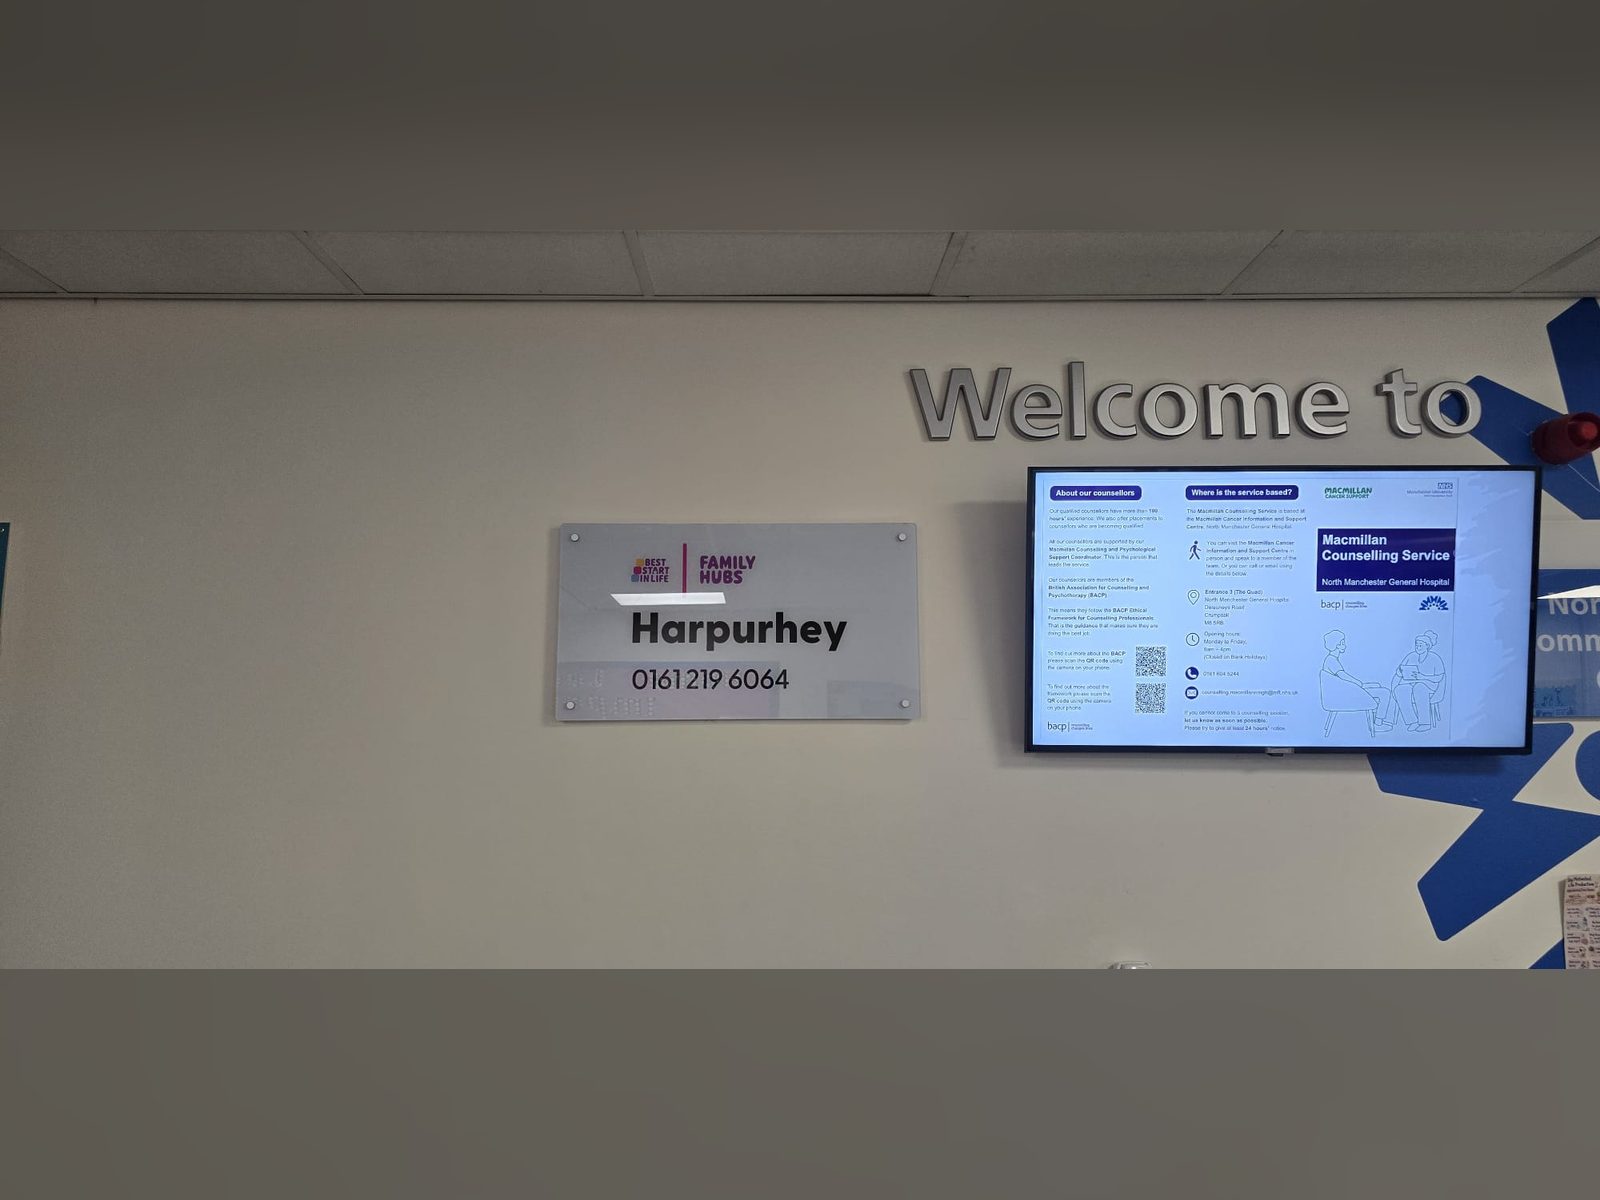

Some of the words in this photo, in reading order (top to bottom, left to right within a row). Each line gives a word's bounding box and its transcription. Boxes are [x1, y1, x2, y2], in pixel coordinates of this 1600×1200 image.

[909, 361, 1349, 440] Welcome
[1376, 368, 1482, 439] to
[1322, 534, 1387, 545] Macmillan
[645, 558, 666, 566] BEST
[1322, 550, 1398, 563] Counselling
[1402, 550, 1450, 561] Service
[700, 556, 756, 570] FAMILY
[640, 574, 650, 582] IN
[650, 574, 669, 582] LIFE
[700, 570, 743, 584] HUBS
[1420, 578, 1450, 587] Hospital
[1321, 600, 1341, 610] bacp
[632, 612, 847, 652] Harpurhey
[632, 669, 680, 690] 0161
[686, 669, 722, 690] 219
[728, 669, 789, 690] 6064
[1047, 721, 1067, 732] bacp
